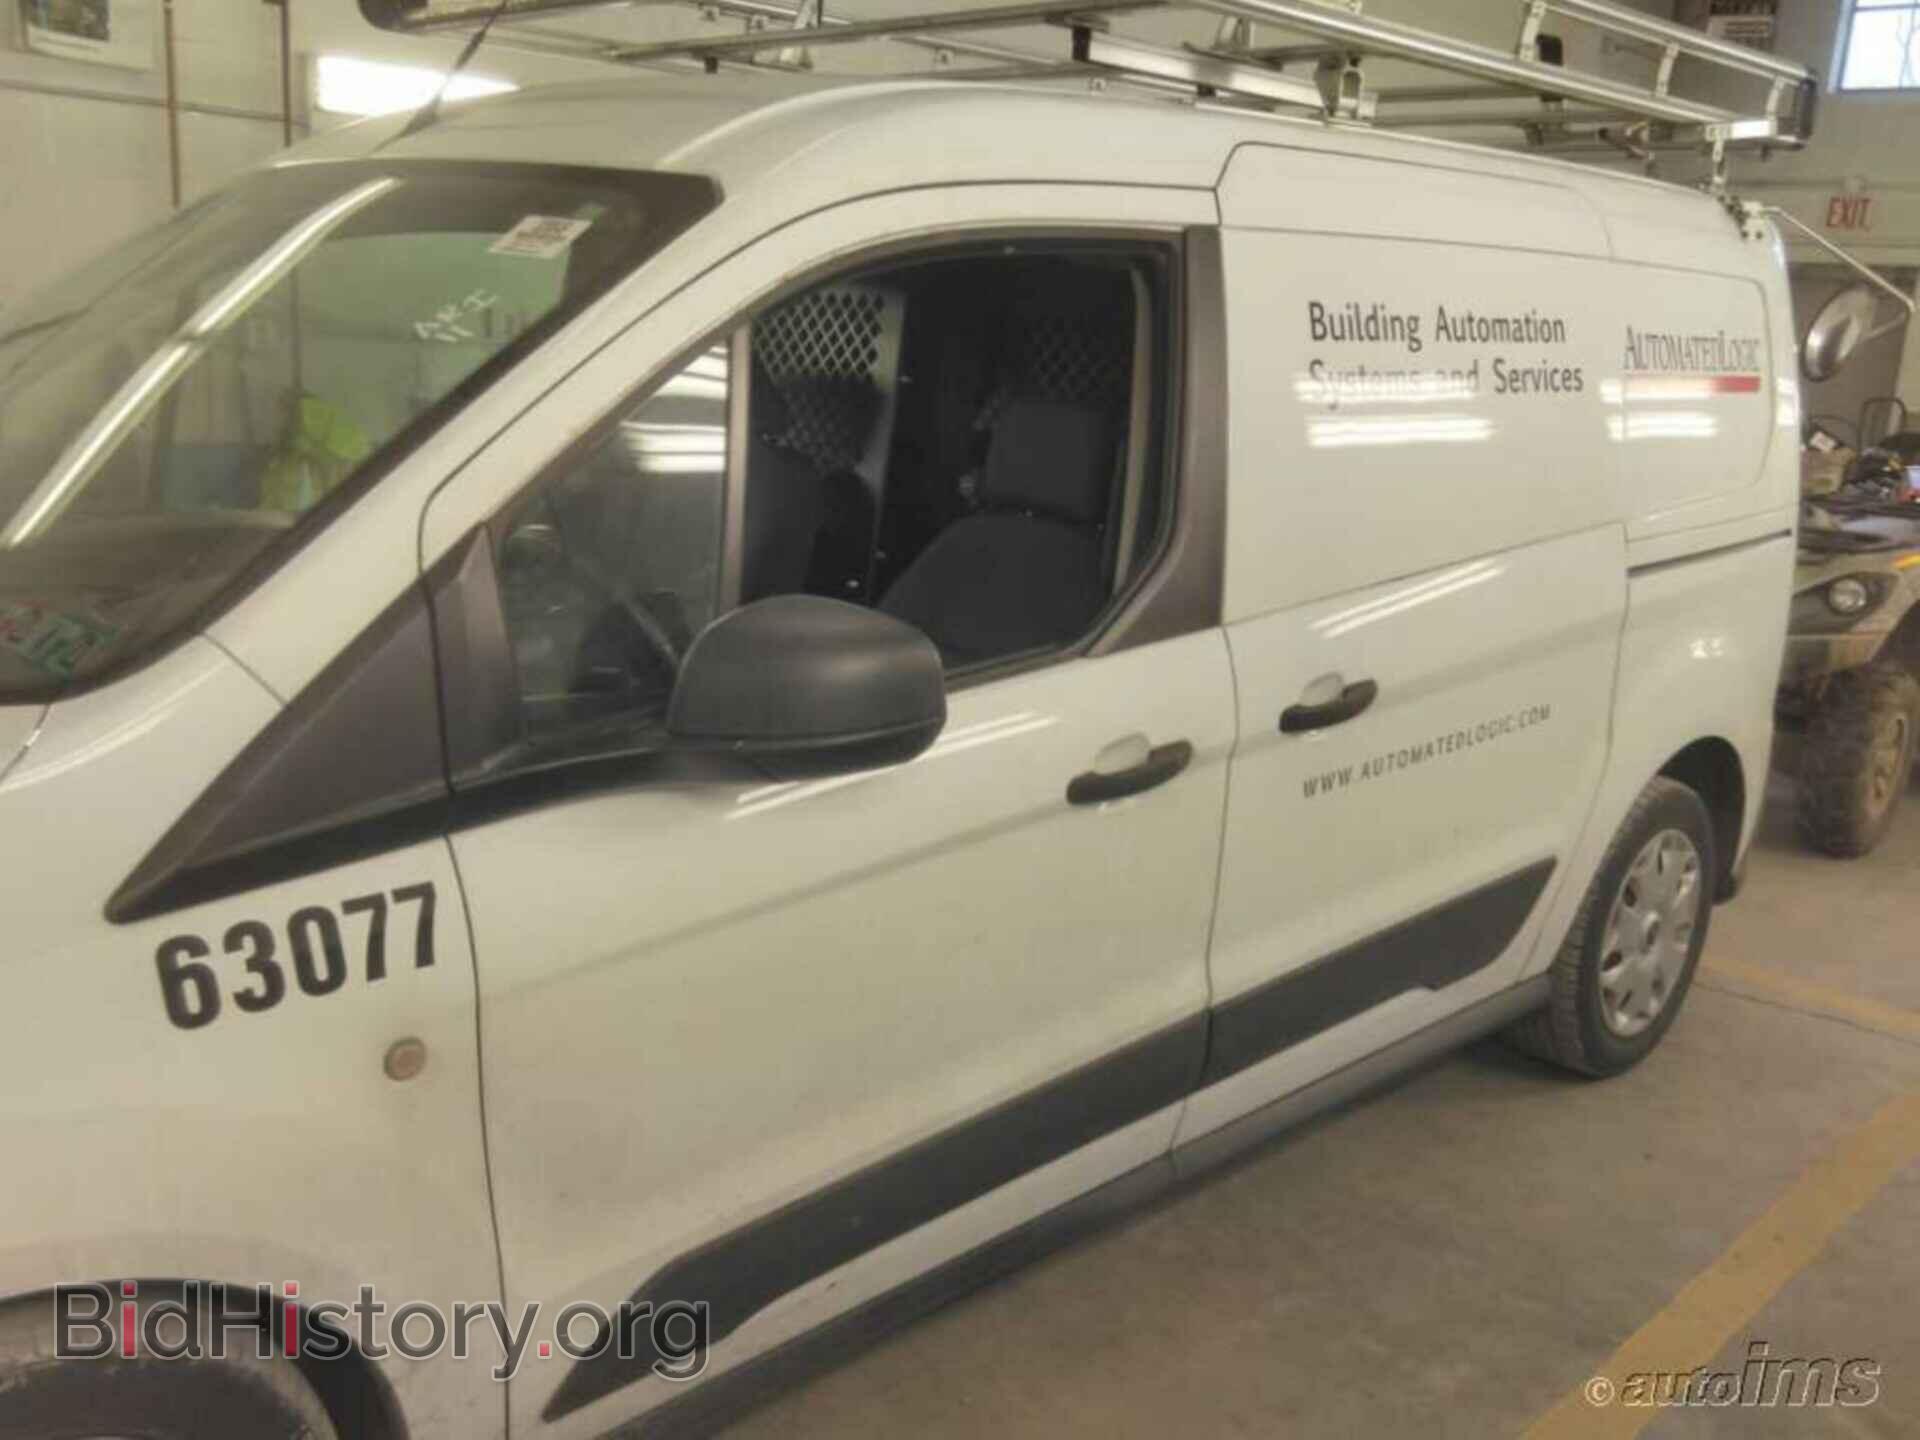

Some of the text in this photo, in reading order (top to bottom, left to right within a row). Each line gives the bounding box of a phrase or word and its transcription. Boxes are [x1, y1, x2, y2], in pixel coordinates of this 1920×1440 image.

[1825, 196, 1872, 230] EXIT
[1308, 301, 1566, 352] Building Automation
[1493, 358, 1584, 394] Services
[155, 881, 436, 1030] 63077
